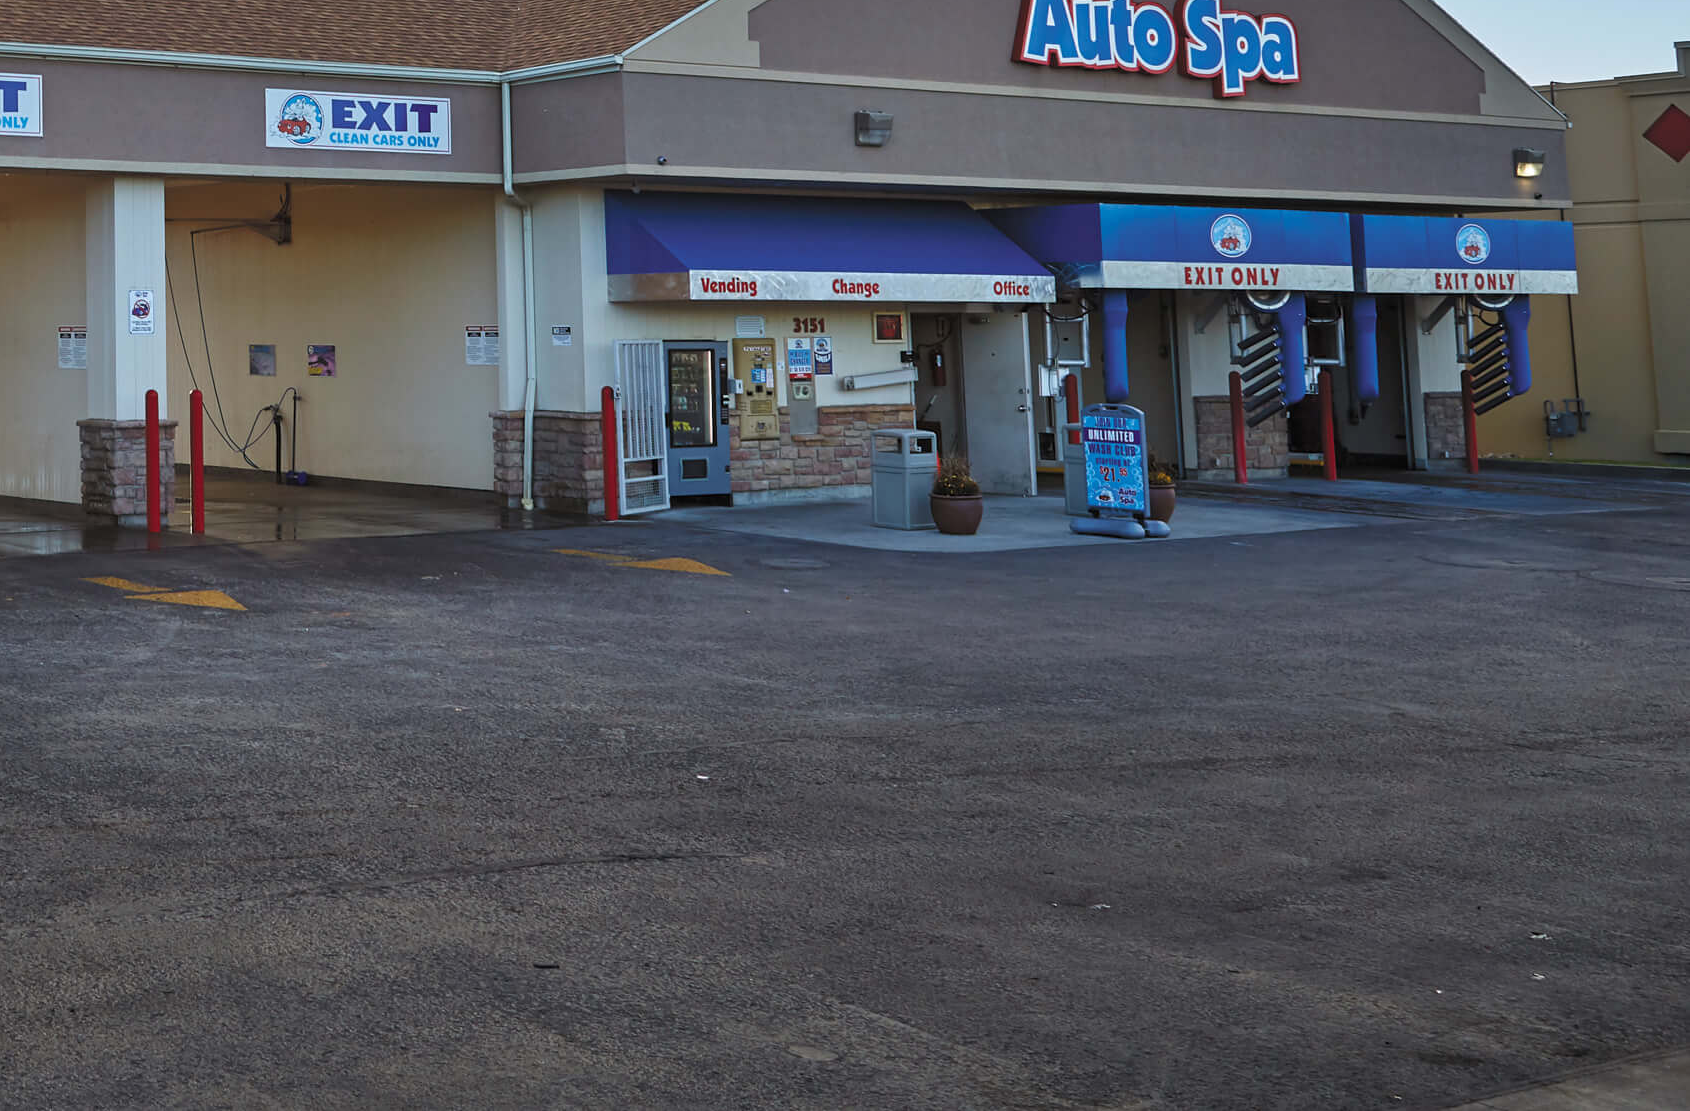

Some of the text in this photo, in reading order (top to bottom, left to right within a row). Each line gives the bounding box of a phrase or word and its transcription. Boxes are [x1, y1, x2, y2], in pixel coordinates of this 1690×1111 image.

[331, 98, 439, 133] EXIT
[329, 132, 441, 148] CLEAN CARS ONLY
[1184, 266, 1280, 286] EXIT ONLY
[1434, 272, 1515, 291] EXIT ONLY
[700, 277, 758, 297] Vending
[831, 278, 881, 298] Change
[993, 281, 1030, 296] Office
[793, 317, 826, 333] 3151
[1088, 429, 1135, 442] UNLIMITED
[1088, 443, 1136, 457] WASH CLUB
[1118, 488, 1137, 496] Auto
[1119, 496, 1135, 505] Spa
